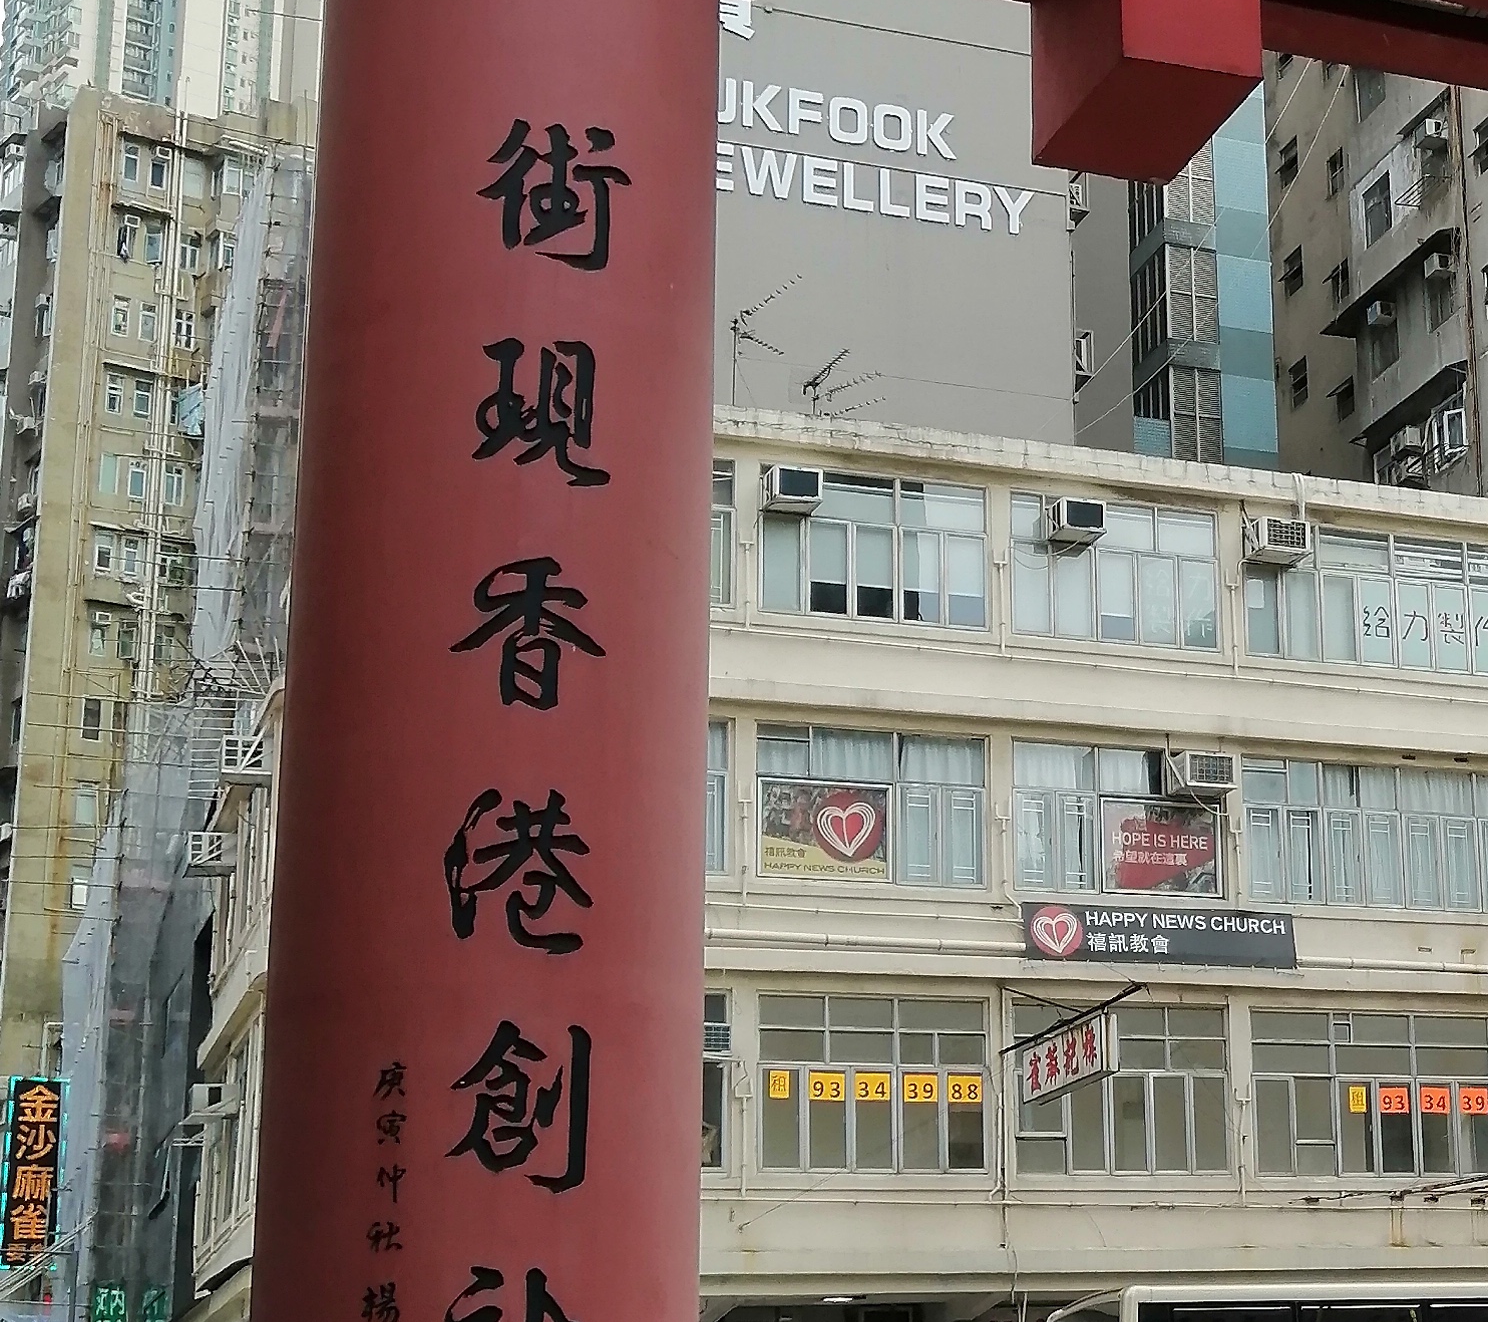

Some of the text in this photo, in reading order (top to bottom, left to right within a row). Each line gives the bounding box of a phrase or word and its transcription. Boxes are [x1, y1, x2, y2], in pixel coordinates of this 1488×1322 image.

[1112, 832, 1209, 850] HOPE IS HERE
[764, 862, 885, 875] HAPPY NEWS CHURCH
[1085, 911, 1287, 935] HAPPY NEWS CHURCH
[1086, 932, 1171, 955] 禧訊教會
[813, 1081, 841, 1098] 93
[858, 1081, 887, 1098] 34
[907, 1082, 934, 1100] 39
[951, 1083, 979, 1100] 88
[1382, 1095, 1405, 1111] 93
[1424, 1095, 1447, 1111] 34
[1462, 1095, 1485, 1112] 39
